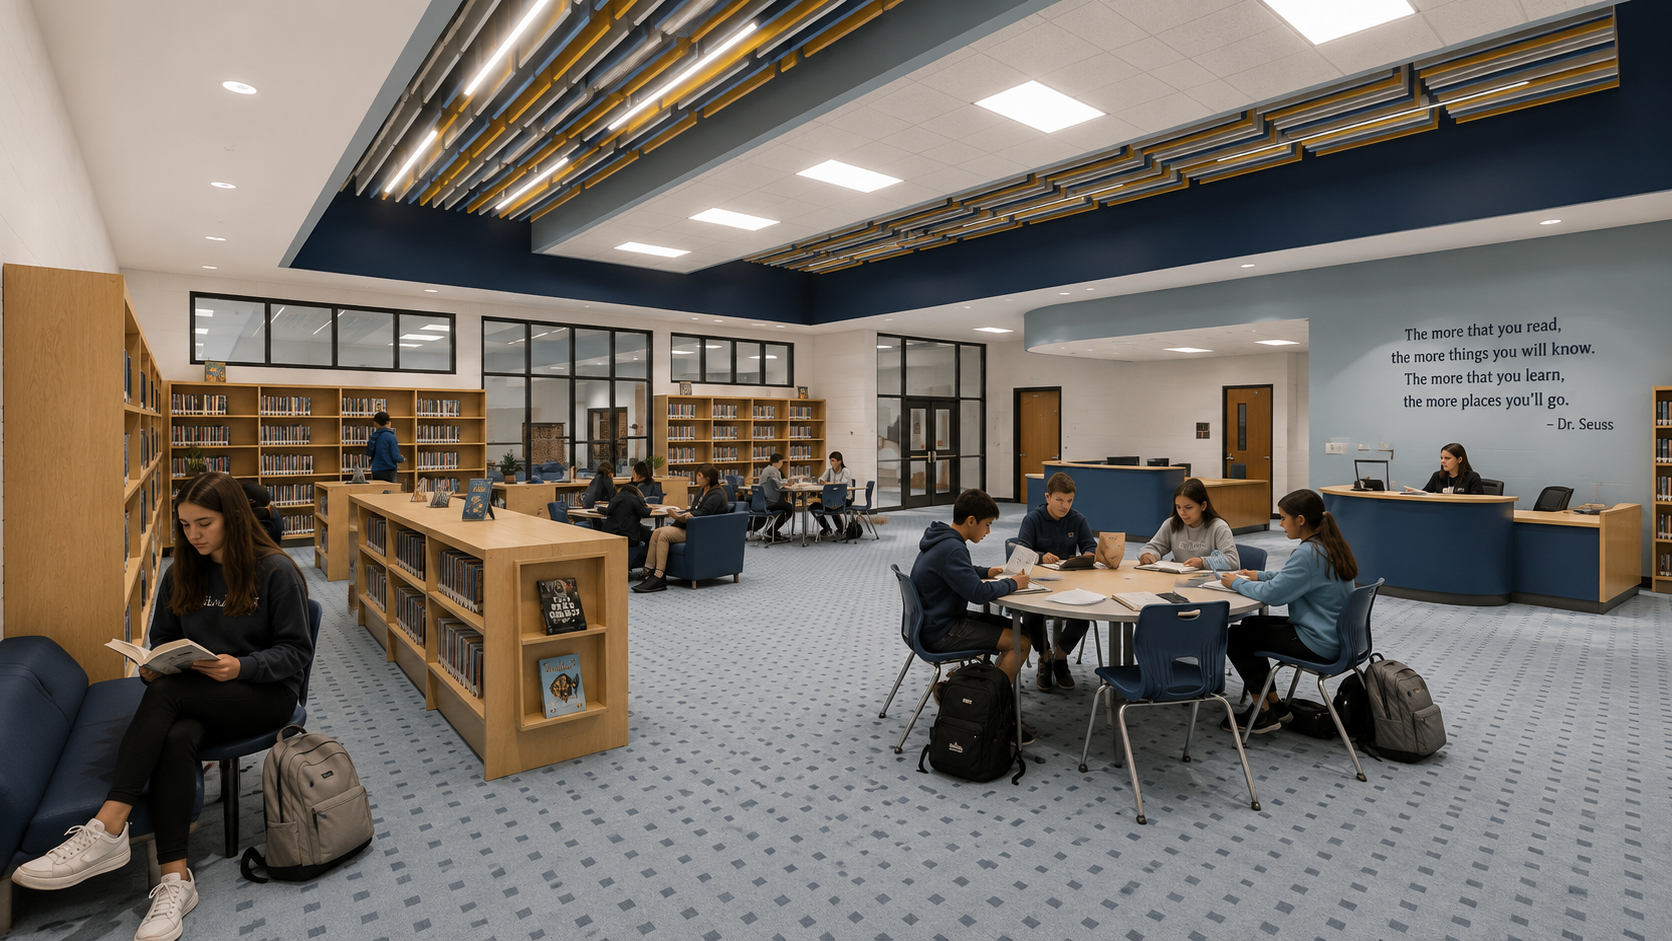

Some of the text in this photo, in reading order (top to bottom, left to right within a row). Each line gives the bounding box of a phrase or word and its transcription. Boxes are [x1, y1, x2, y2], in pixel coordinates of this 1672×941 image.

[1405, 317, 1561, 341] The more that you read,
[1391, 342, 1595, 363] the more things you will know.
[1404, 368, 1564, 386] The more that you learn,
[1404, 392, 1569, 410] the more places you'll go.
[1558, 418, 1575, 430] Dr.
[1579, 418, 1614, 430] Seuss
